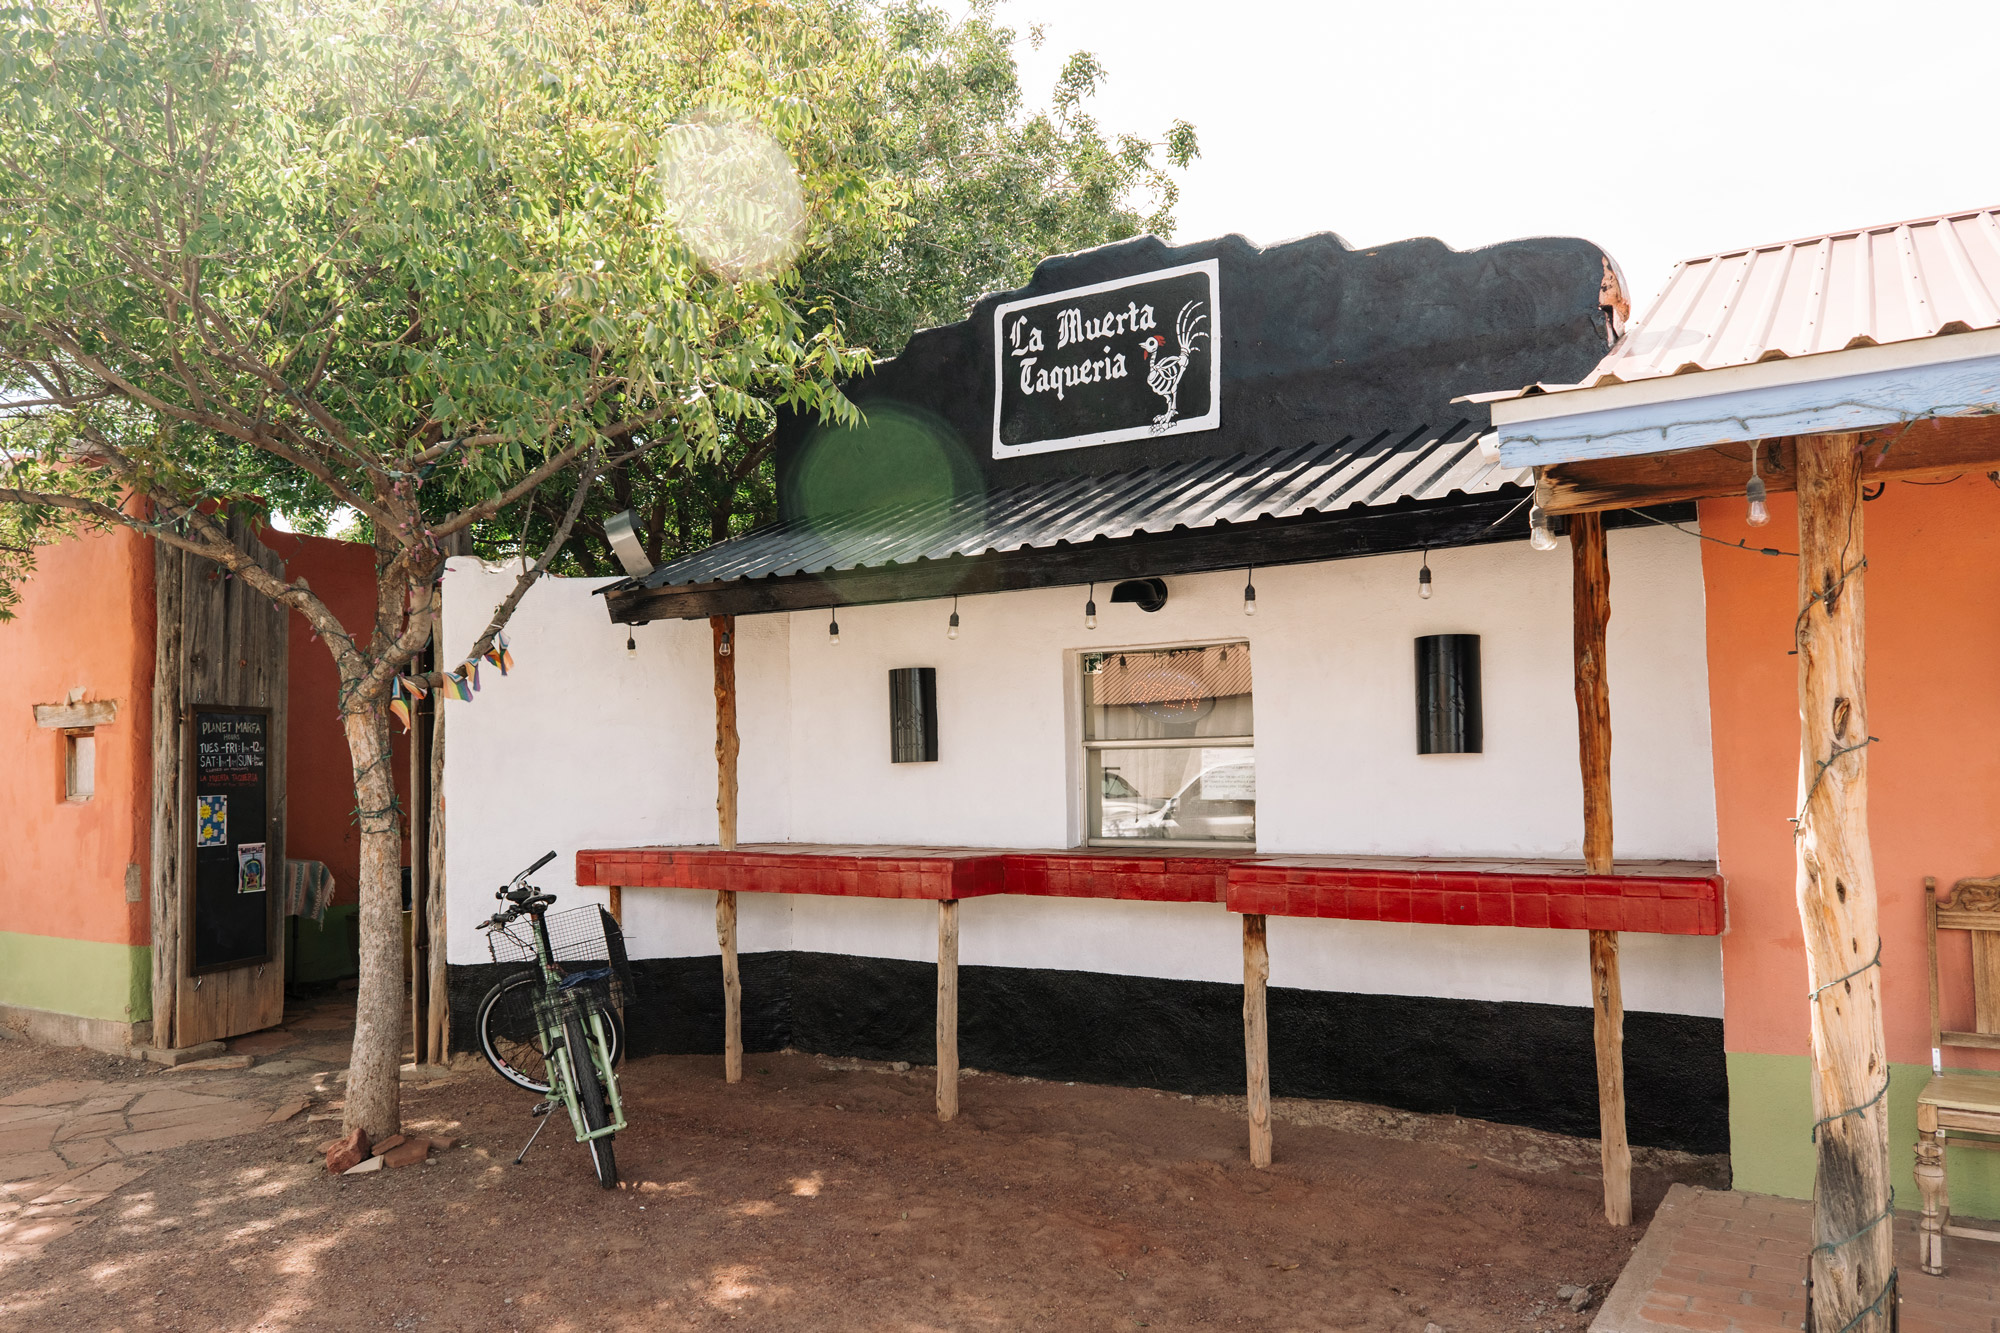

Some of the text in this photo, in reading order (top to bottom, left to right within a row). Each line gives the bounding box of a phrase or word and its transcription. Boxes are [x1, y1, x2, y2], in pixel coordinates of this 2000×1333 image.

[1009, 301, 1157, 357] La Muerta
[1020, 345, 1129, 401] Taqueria
[1131, 681, 1204, 712] OPEN
[202, 721, 261, 735] PLANET MARFA
